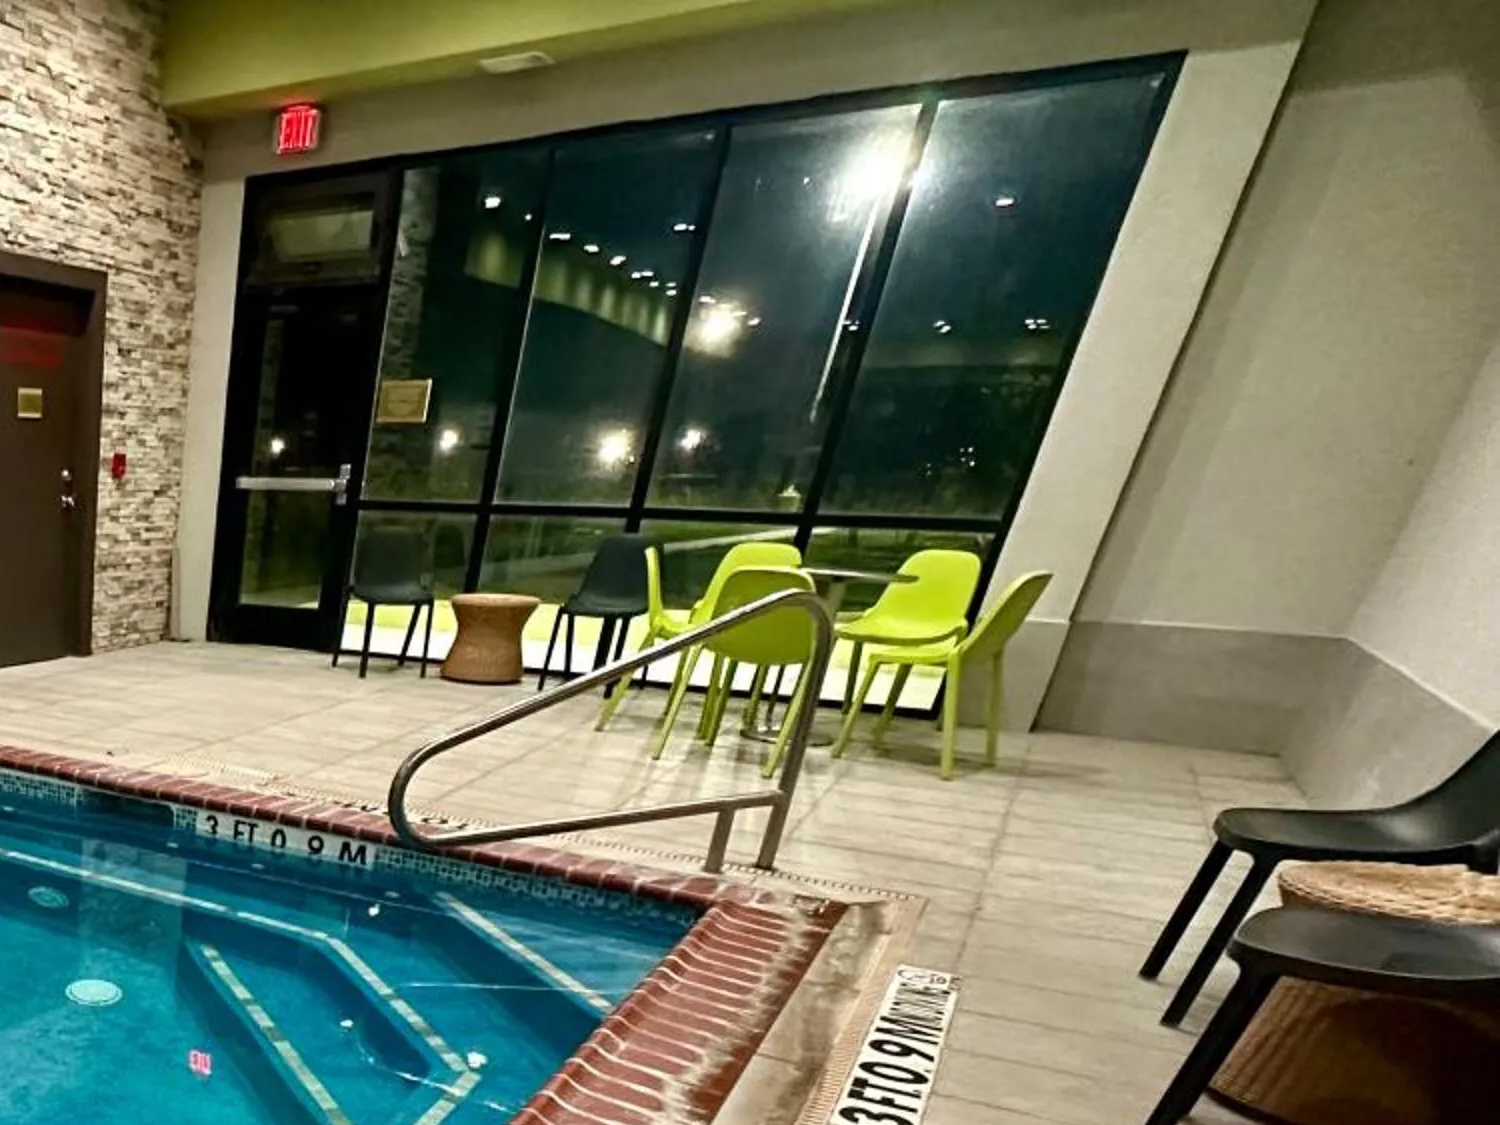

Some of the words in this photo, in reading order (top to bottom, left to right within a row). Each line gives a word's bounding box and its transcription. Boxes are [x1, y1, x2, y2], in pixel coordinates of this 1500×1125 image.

[205, 815, 219, 835] 3
[233, 820, 259, 843] FT
[338, 841, 367, 865] M
[875, 1016, 944, 1046] M
